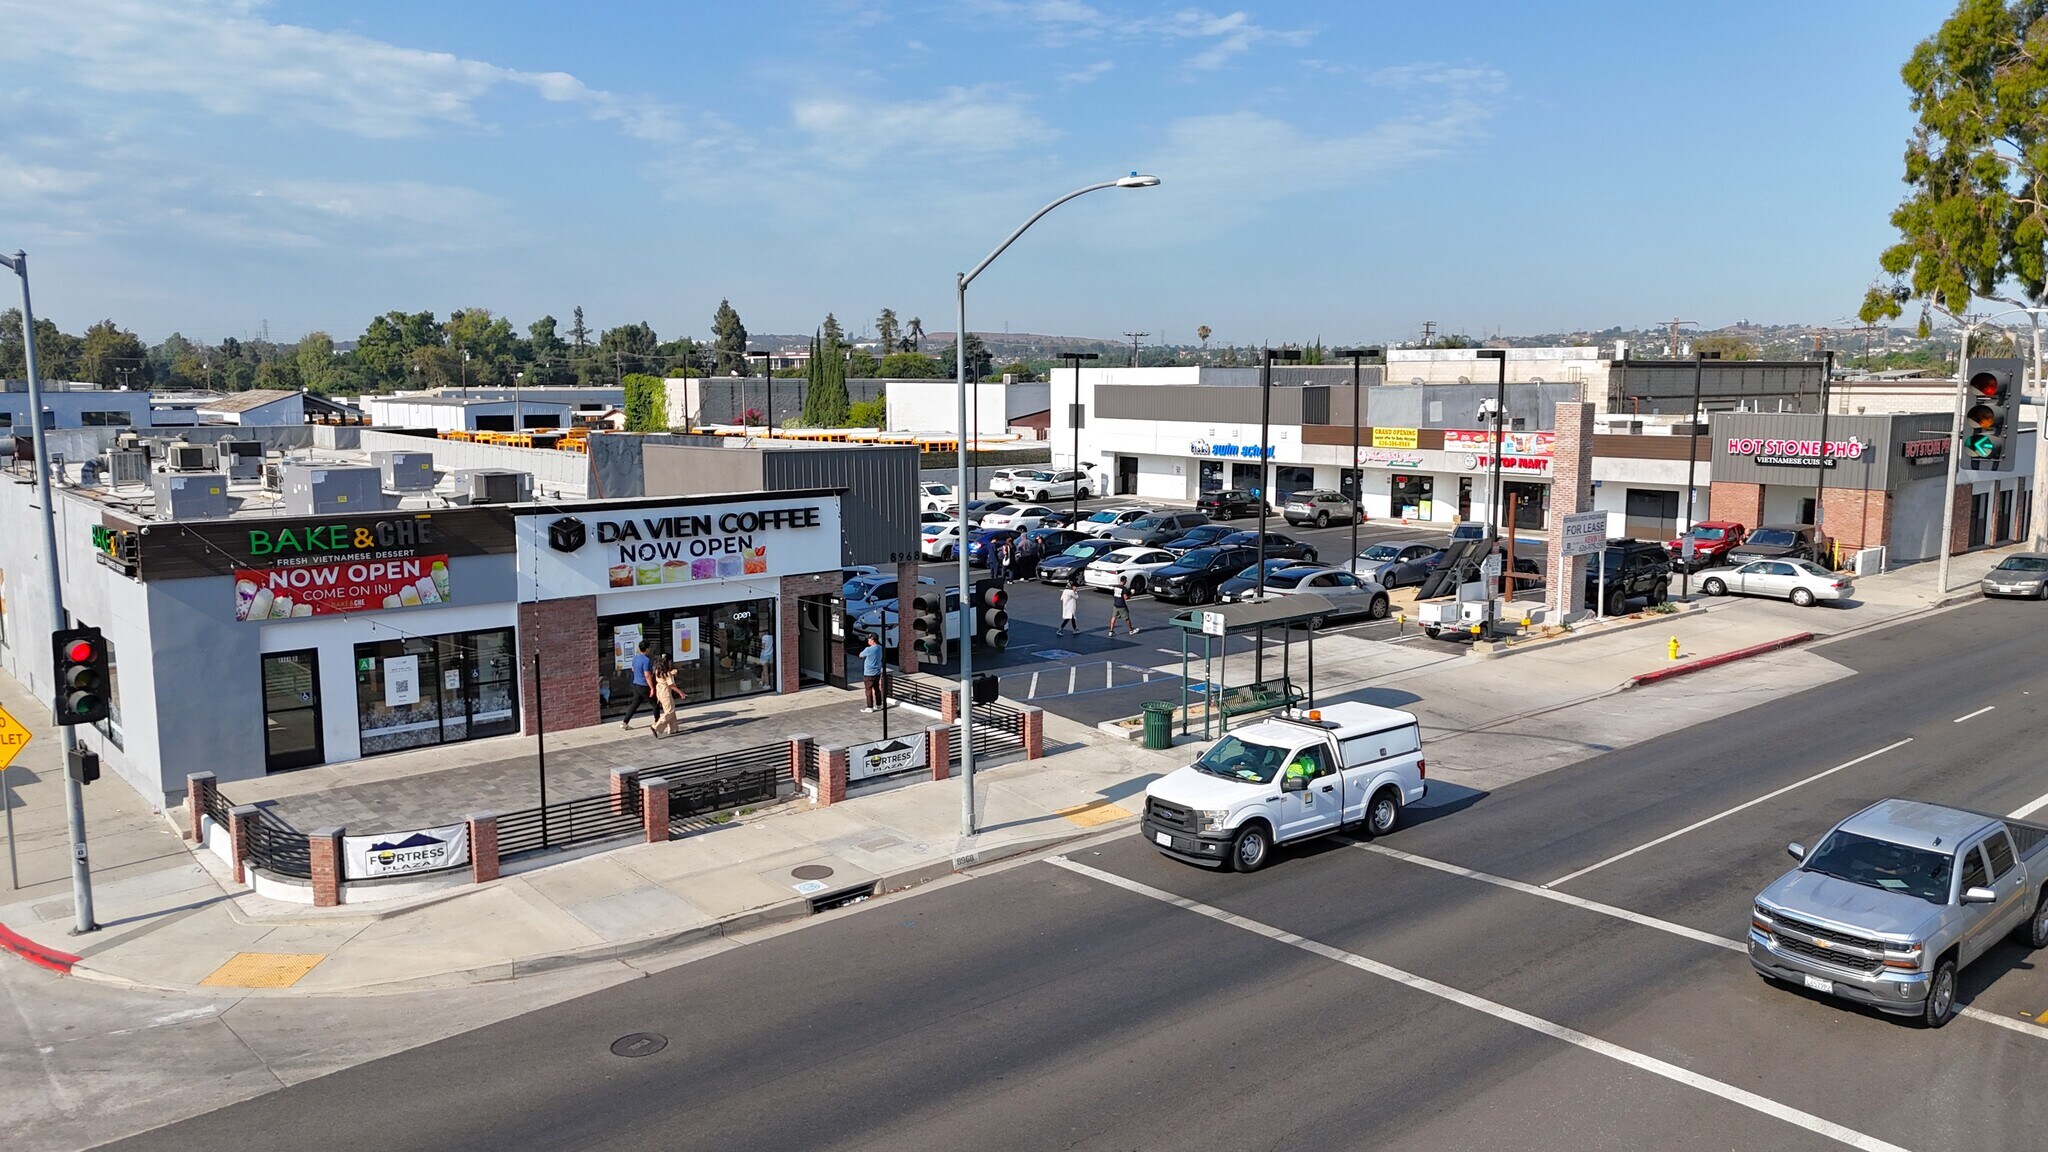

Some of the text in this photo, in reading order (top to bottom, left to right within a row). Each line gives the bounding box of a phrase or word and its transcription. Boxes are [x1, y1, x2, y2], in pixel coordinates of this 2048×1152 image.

[1212, 443, 1239, 456] swim
[1728, 438, 1764, 454] HOT
[1765, 438, 1822, 456] STONE
[1905, 441, 1919, 457] HOT
[1919, 440, 1941, 456] STONE
[1518, 459, 1548, 470] MART
[1757, 456, 1802, 465] VIETNAMESE
[719, 507, 821, 534] COFFEE
[1566, 522, 1604, 536] FOR LEASE
[620, 535, 752, 563] NOW OPEN
[277, 549, 414, 566] FRESH VIETNAMESE DESSERT
[890, 550, 920, 562] 8968
[269, 560, 420, 589] NOW OPEN
[303, 584, 392, 601] COME ON IN!
[733, 611, 751, 621] open
[361, 660, 368, 668] A
[873, 763, 903, 772] PLAZA
[383, 861, 431, 871] PLAZA
[956, 855, 974, 865] 8968
